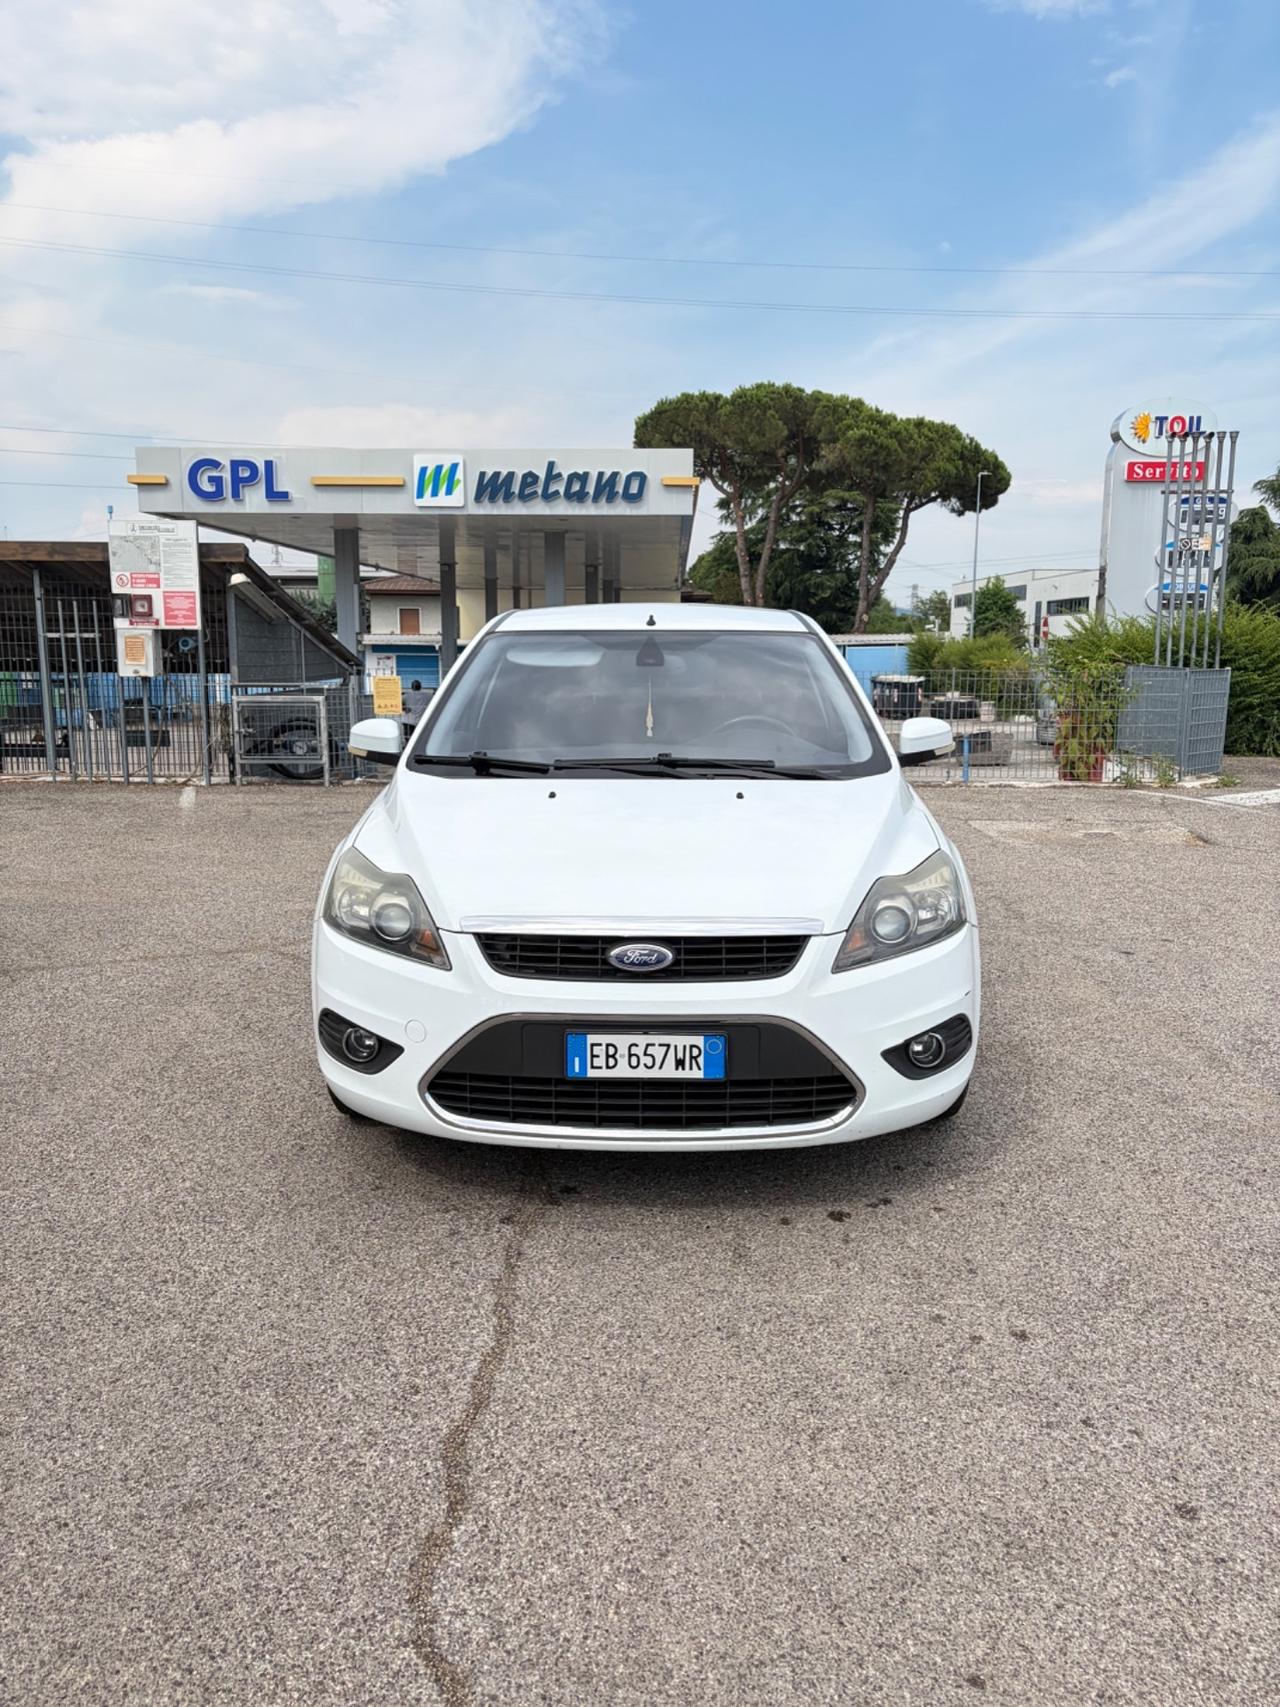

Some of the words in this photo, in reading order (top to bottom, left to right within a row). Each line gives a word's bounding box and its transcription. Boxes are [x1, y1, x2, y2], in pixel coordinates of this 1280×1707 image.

[187, 457, 291, 501] GPL
[474, 460, 648, 504] metano
[623, 949, 658, 964] Ford
